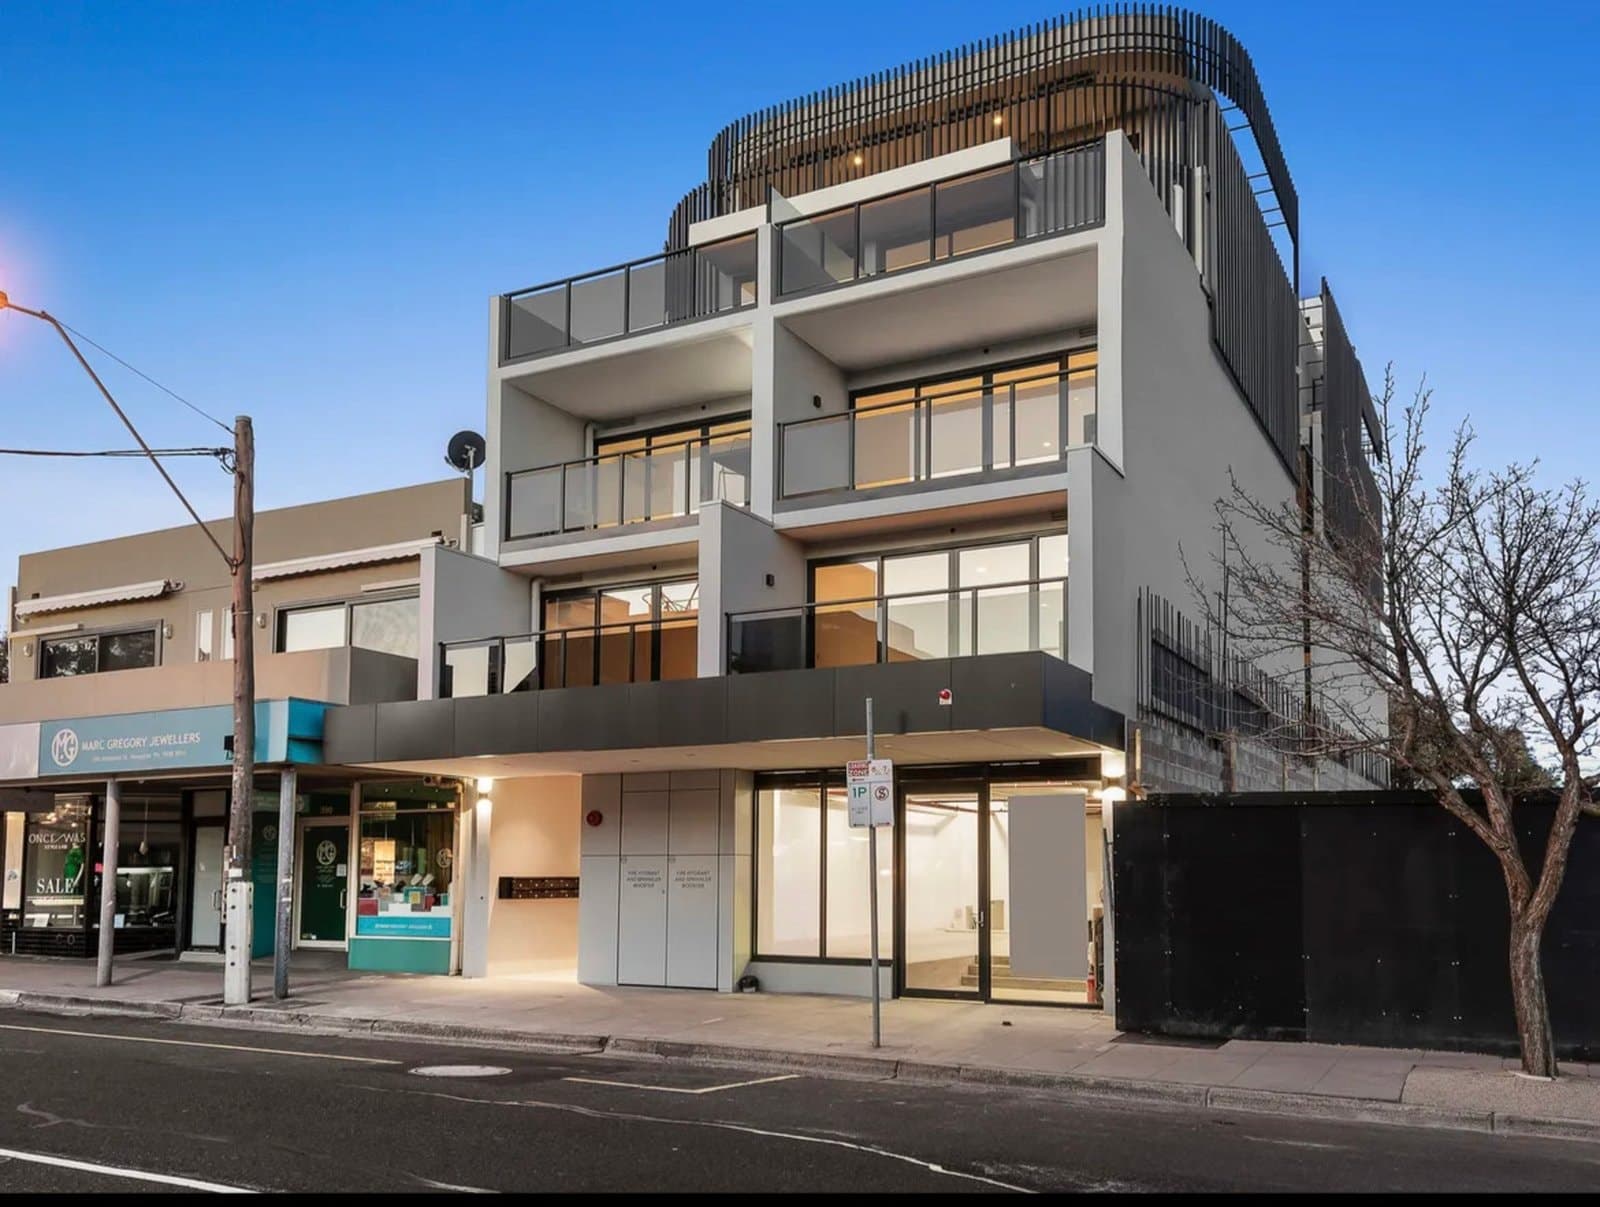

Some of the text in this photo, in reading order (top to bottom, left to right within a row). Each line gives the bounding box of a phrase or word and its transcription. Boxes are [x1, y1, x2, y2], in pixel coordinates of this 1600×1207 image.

[82, 732, 201, 751] MARC GREGORY JEWELLERS
[853, 786, 867, 798] 1P
[28, 833, 56, 844] ONCE
[36, 878, 74, 894] SALE
